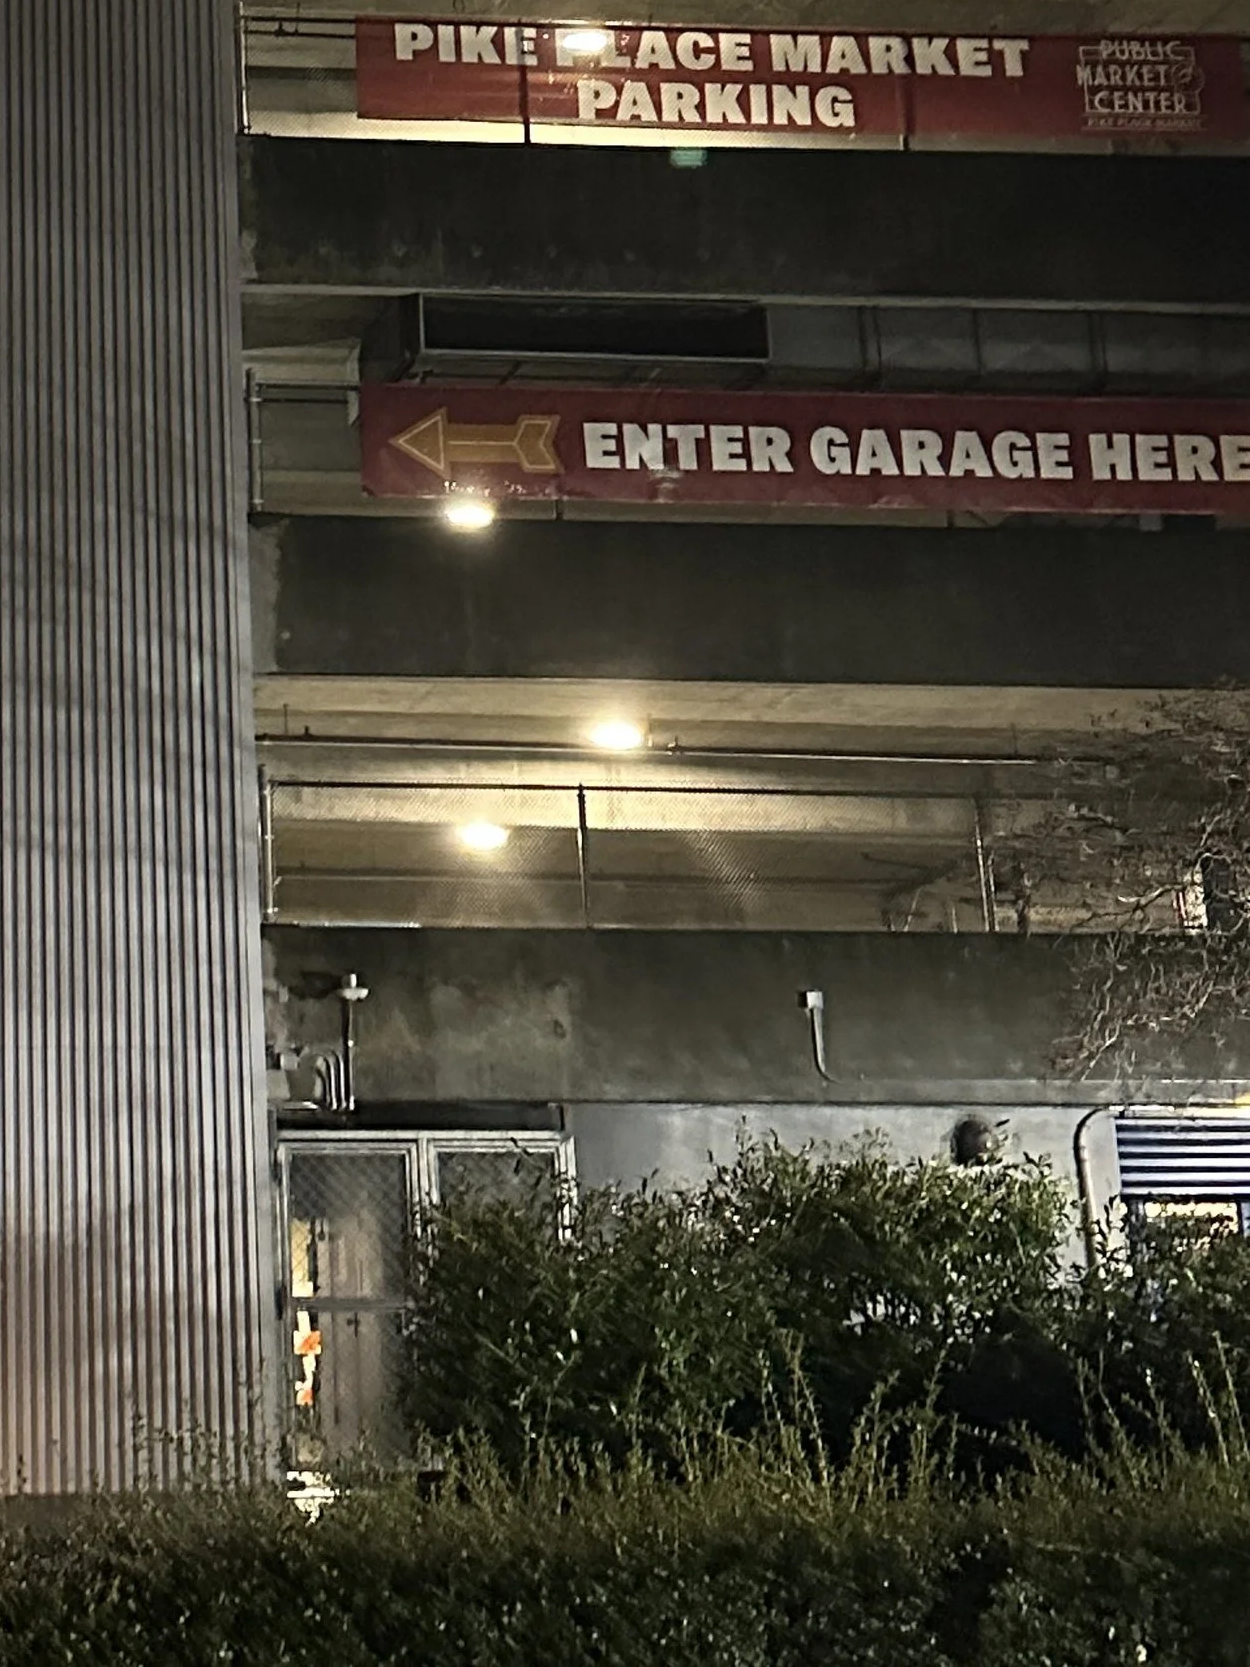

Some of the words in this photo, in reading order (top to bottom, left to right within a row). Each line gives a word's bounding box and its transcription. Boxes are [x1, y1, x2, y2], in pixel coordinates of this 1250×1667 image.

[395, 23, 538, 66] PIKE
[555, 28, 754, 71] PLACE
[769, 34, 1030, 77] MARKET
[1100, 39, 1185, 62] PUBLIC
[1076, 64, 1169, 87] MARKET
[578, 79, 856, 128] PARKING
[1093, 90, 1188, 114] CENTER
[583, 422, 794, 473] ENTER
[810, 425, 1074, 480] GARAGE
[1088, 433, 1250, 482] HERE
